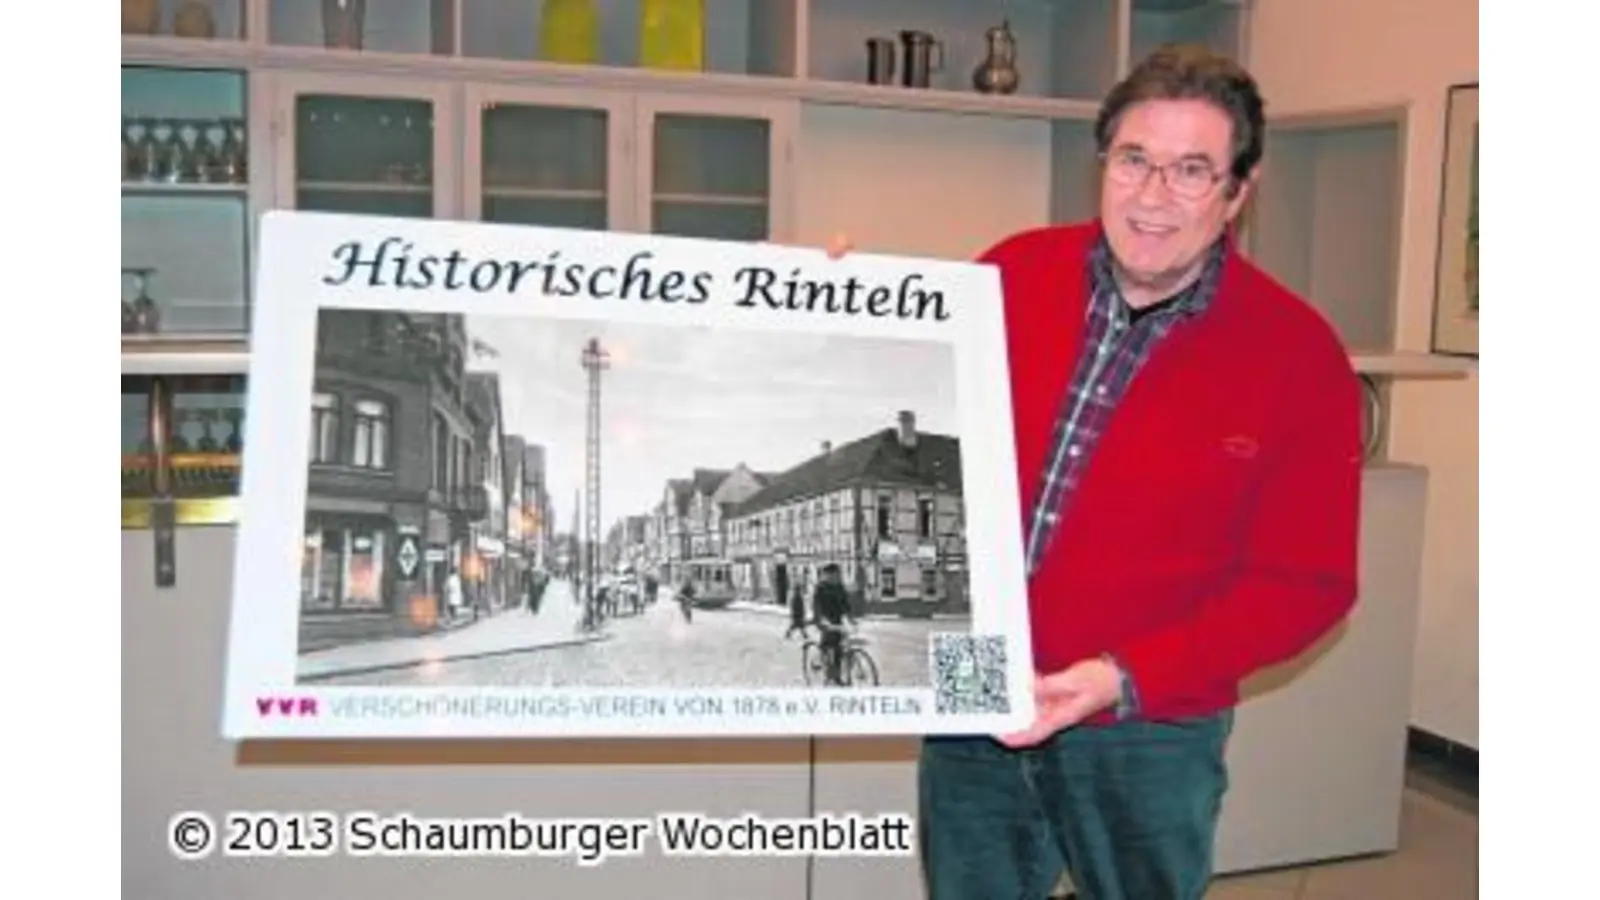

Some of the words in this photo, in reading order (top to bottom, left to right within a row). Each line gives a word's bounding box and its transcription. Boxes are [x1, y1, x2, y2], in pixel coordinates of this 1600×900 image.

[322, 237, 713, 306] Historisches
[733, 266, 951, 322] Rinteln
[256, 697, 319, 717] VVR
[674, 697, 723, 716] VON
[732, 697, 780, 716] 1878
[828, 696, 922, 716] RINTELN
